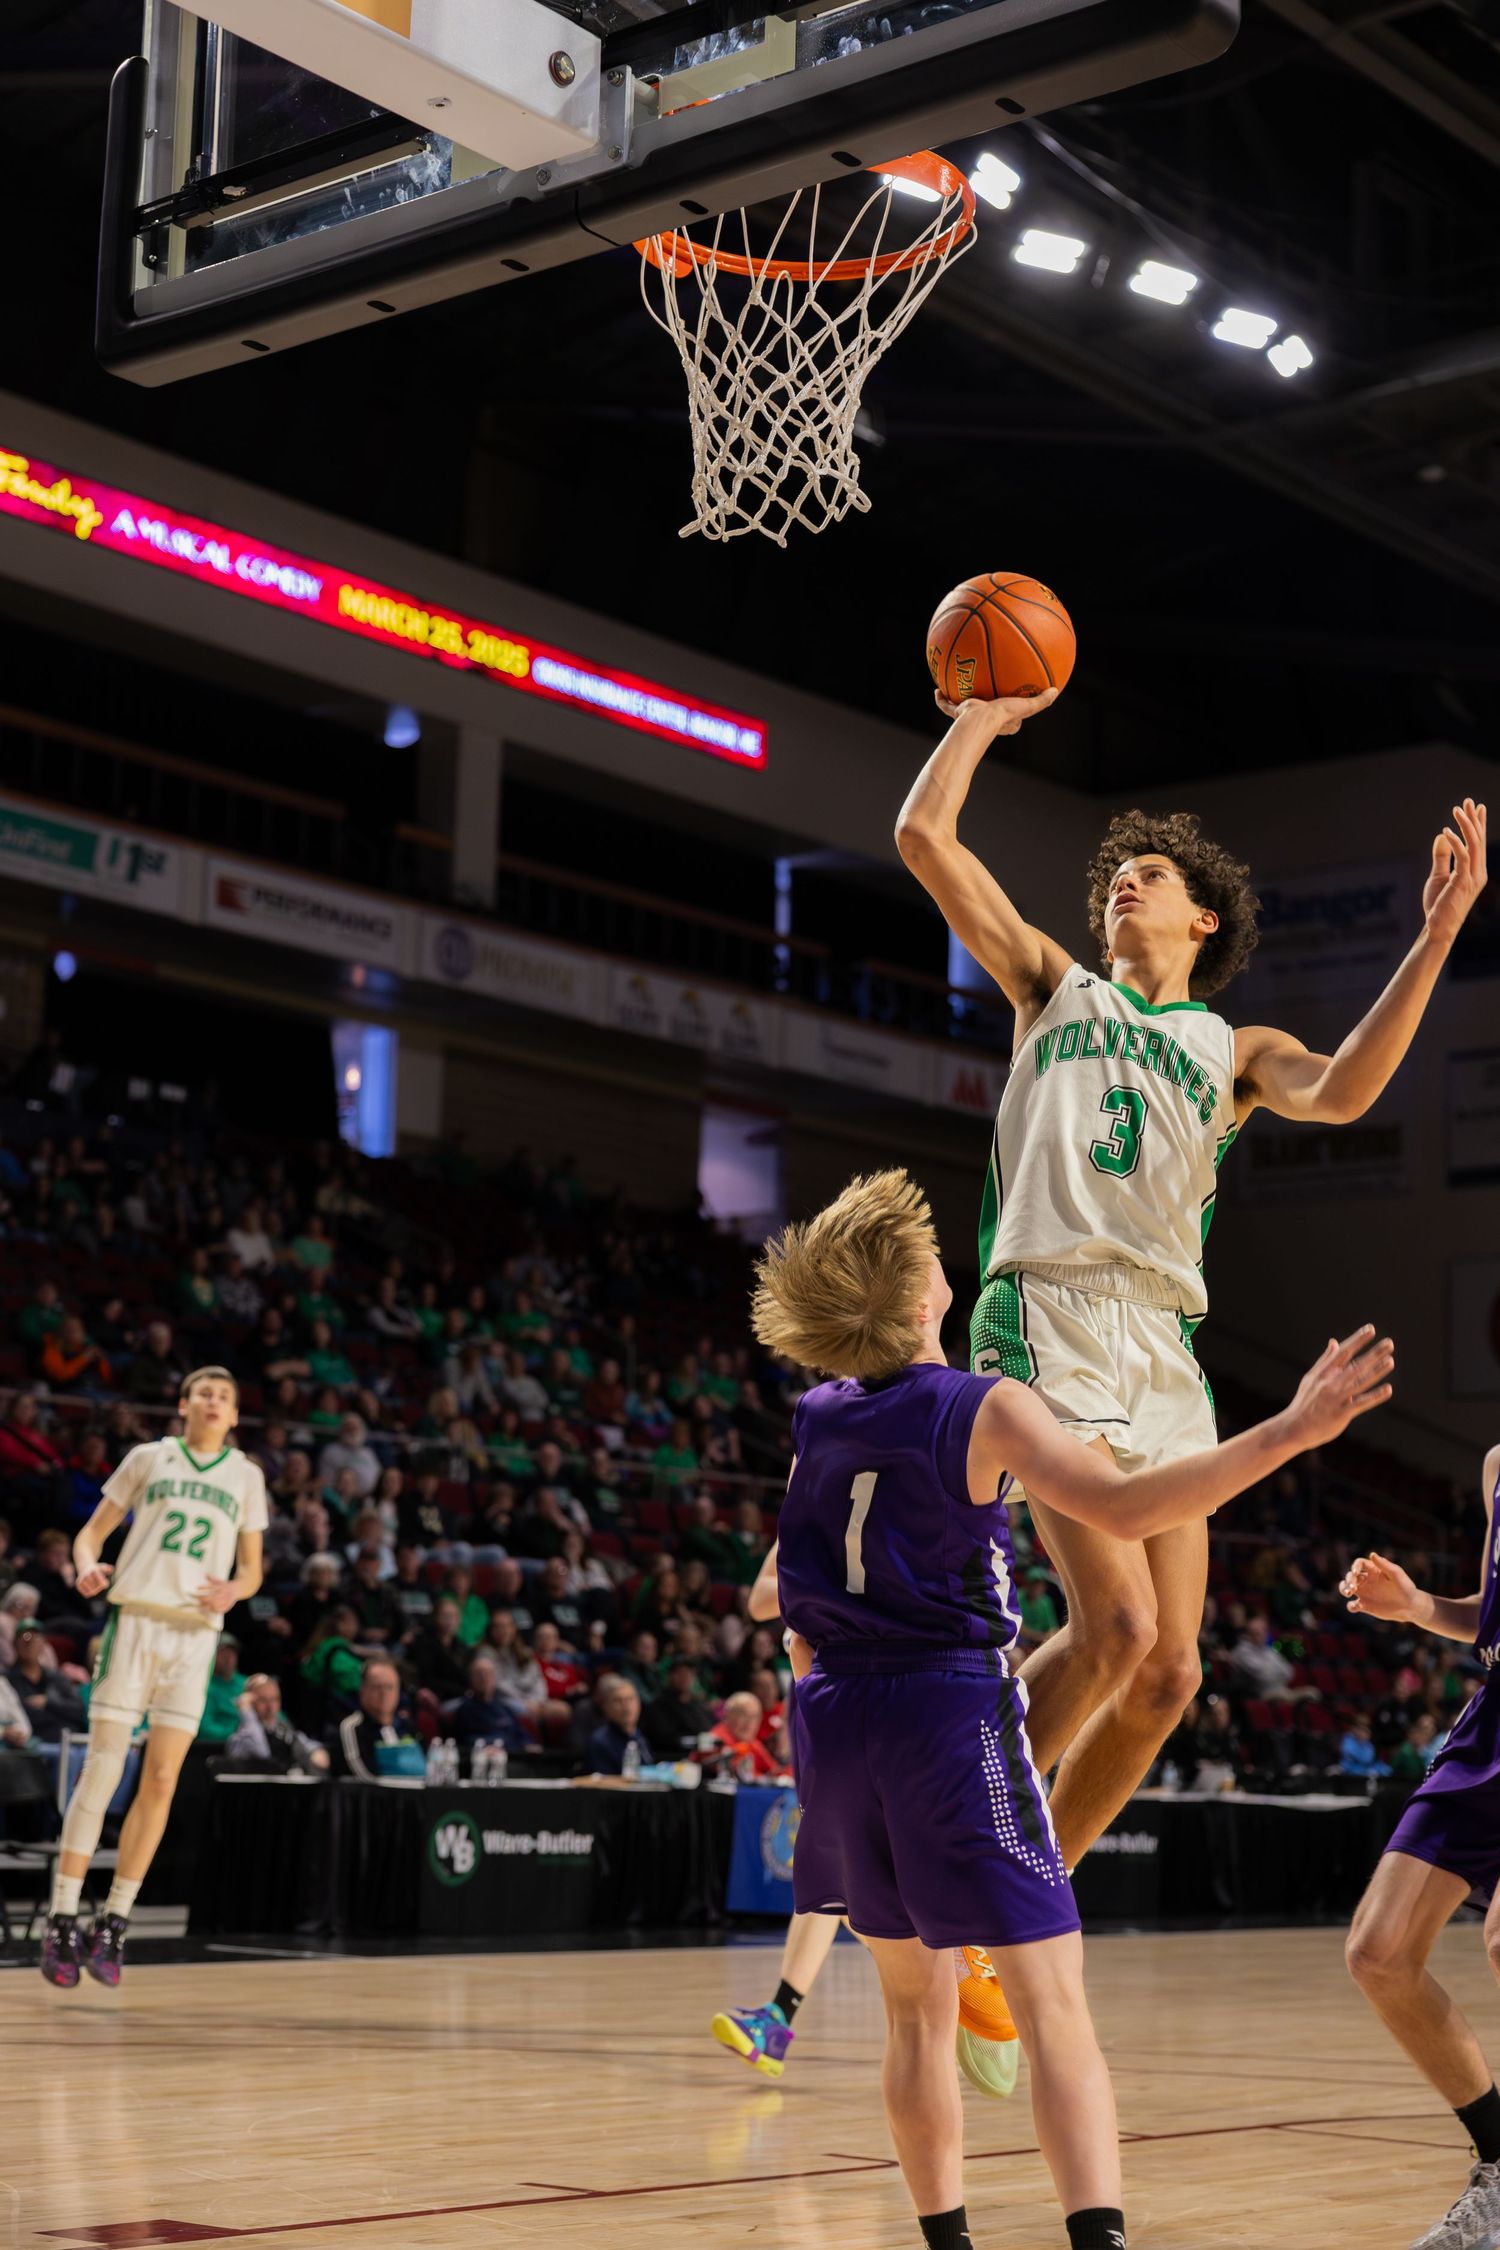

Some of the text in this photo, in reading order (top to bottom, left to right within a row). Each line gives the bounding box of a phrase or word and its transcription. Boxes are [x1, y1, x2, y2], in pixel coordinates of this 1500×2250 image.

[338, 584, 430, 644] MARCH
[1034, 1016, 1218, 1126] WOLVERINES
[1088, 1084, 1149, 1179] 3
[159, 1510, 213, 1561] 22
[845, 1470, 878, 1594] 1
[482, 1829, 594, 1855] Ware-Butler
